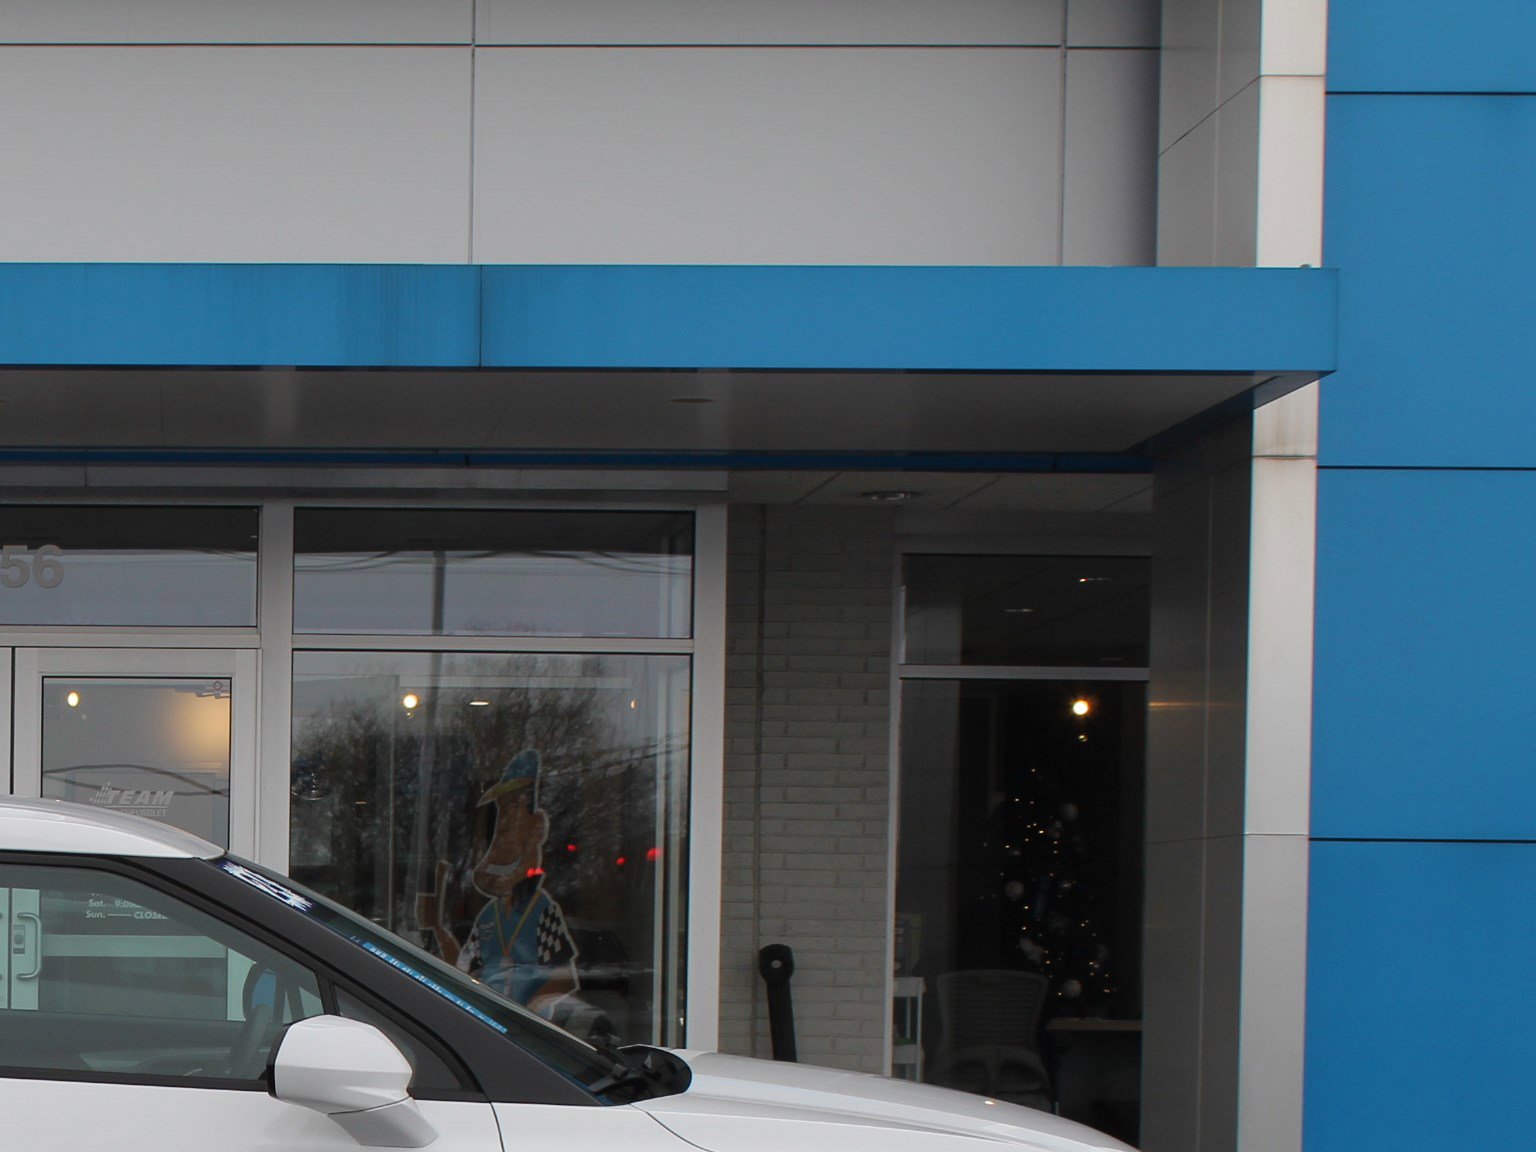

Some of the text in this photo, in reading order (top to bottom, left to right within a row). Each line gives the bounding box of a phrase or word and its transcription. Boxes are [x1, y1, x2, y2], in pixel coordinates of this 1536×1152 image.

[105, 790, 175, 805] TEAM
[88, 899, 106, 907] Sat.
[86, 910, 168, 919] Sun. CLOSE
